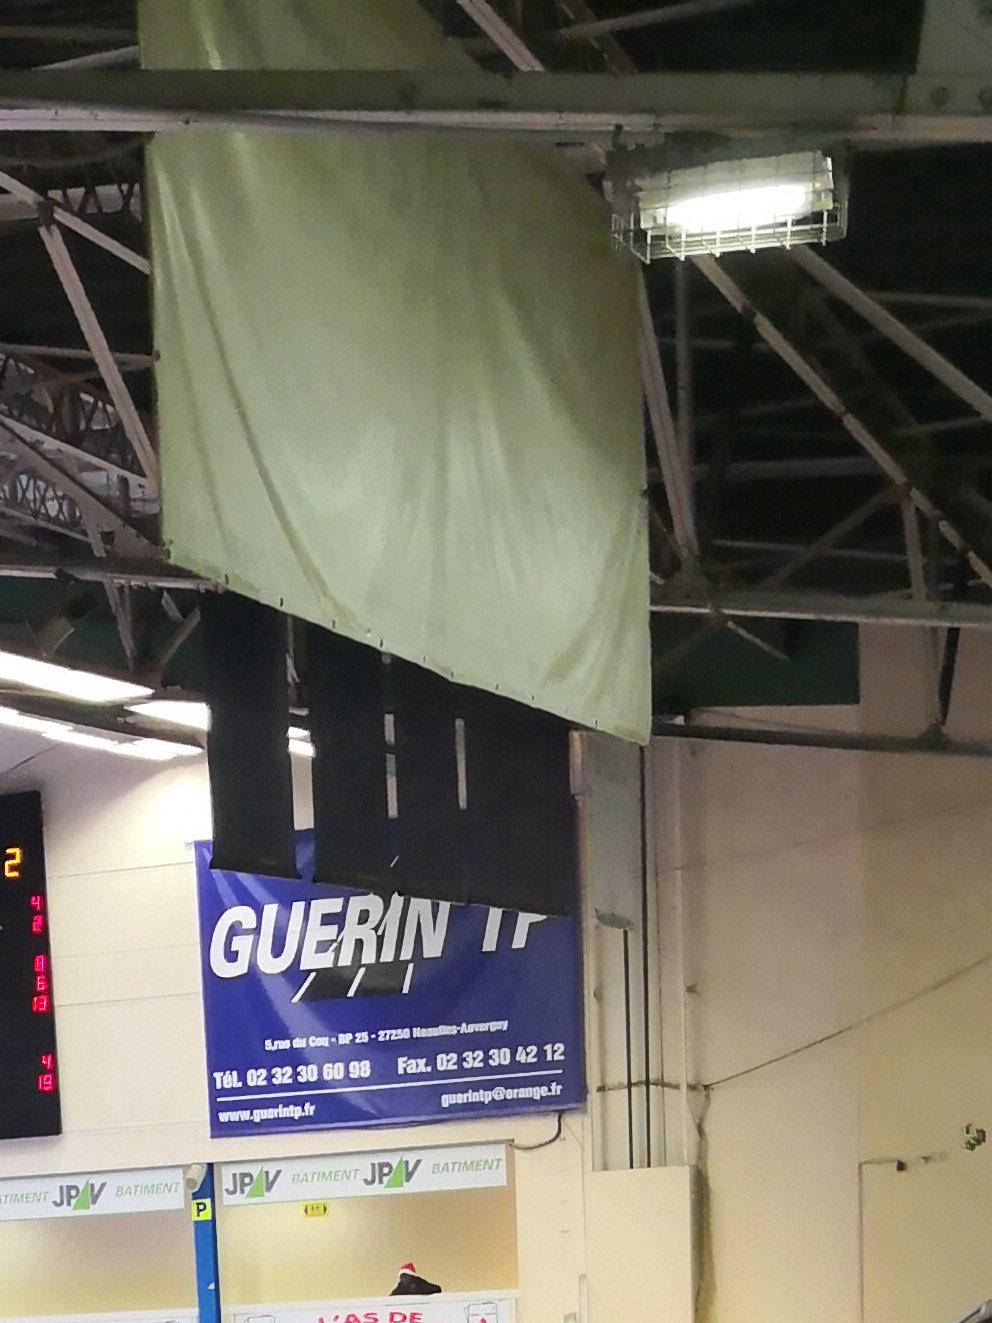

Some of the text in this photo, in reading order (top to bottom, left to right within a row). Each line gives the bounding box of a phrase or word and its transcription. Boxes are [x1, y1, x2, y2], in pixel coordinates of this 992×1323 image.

[4, 847, 23, 878] 2
[209, 892, 450, 978] GUERIN
[397, 1043, 565, 1075] Fax. 02 32 30 42 12
[213, 1060, 371, 1090] Tél. 02 32 30 60 98
[291, 1168, 360, 1184] BATIMENT
[432, 1158, 502, 1174] BATIMENT
[115, 1182, 180, 1197] BATIMENT
[196, 1202, 207, 1217] P
